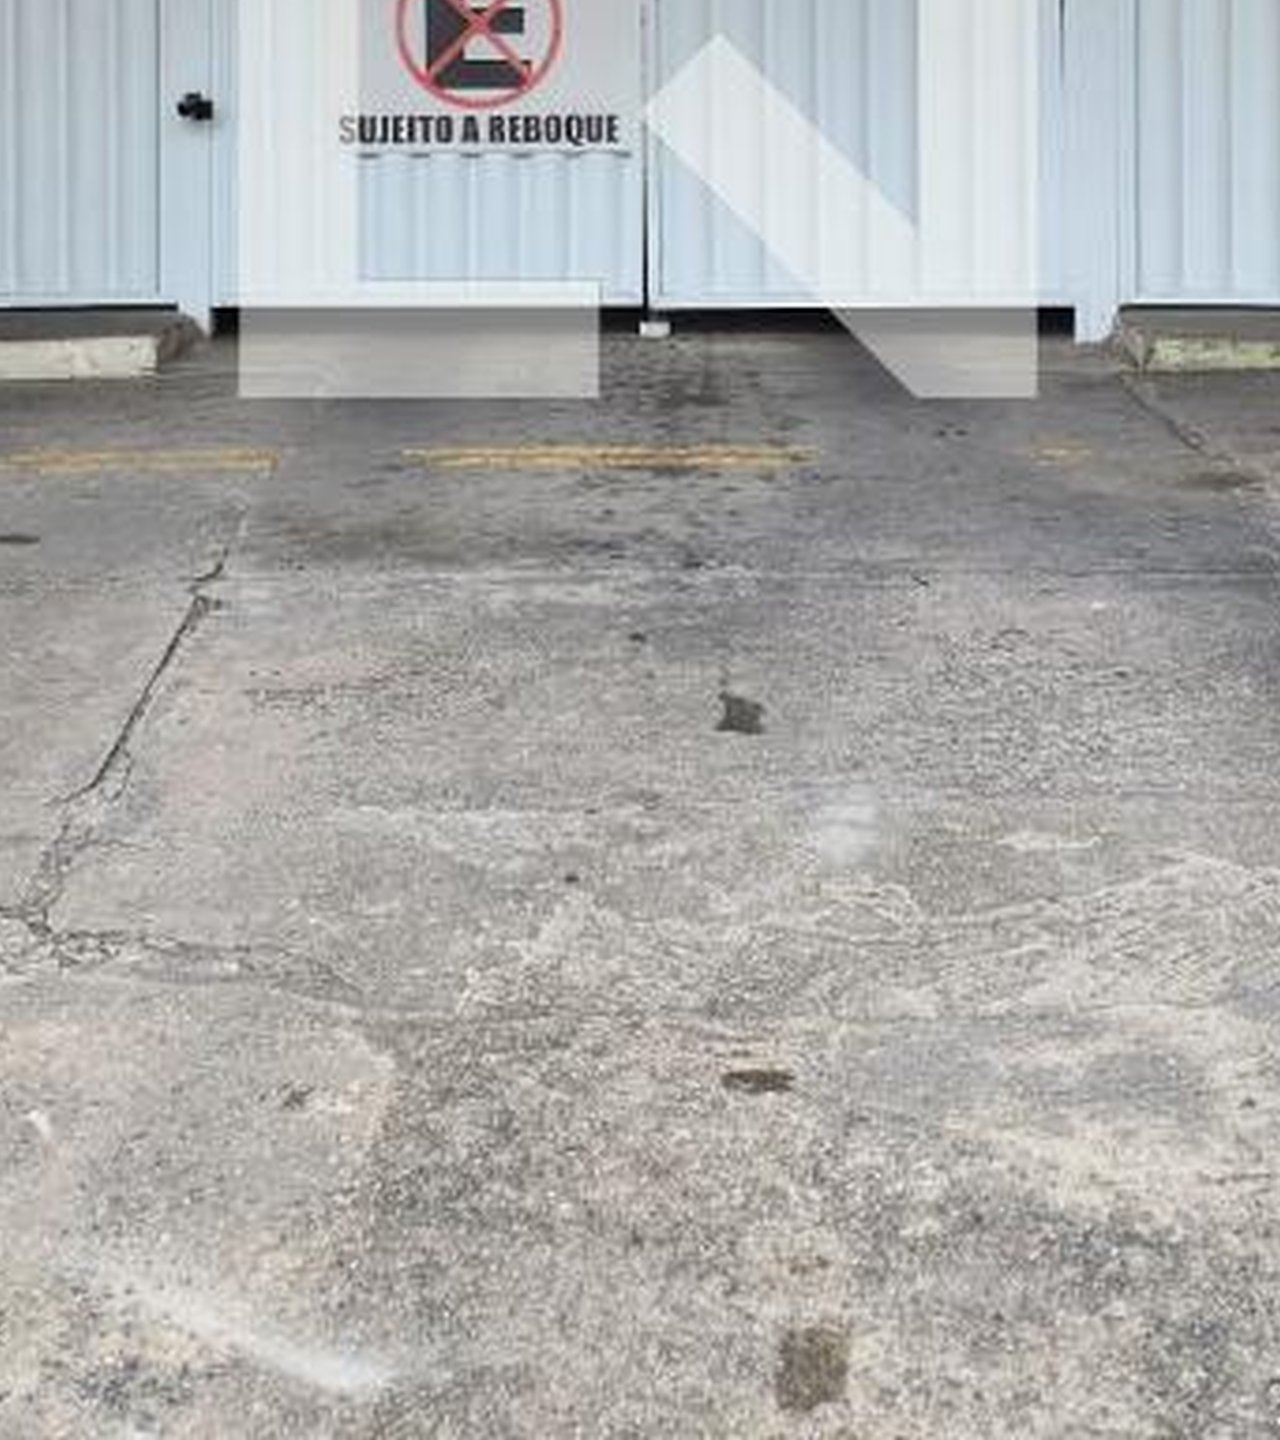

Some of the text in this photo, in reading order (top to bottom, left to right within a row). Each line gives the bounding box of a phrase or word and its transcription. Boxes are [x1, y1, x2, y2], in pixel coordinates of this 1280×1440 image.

[339, 114, 621, 148] SUJEITO A REBOQUE
